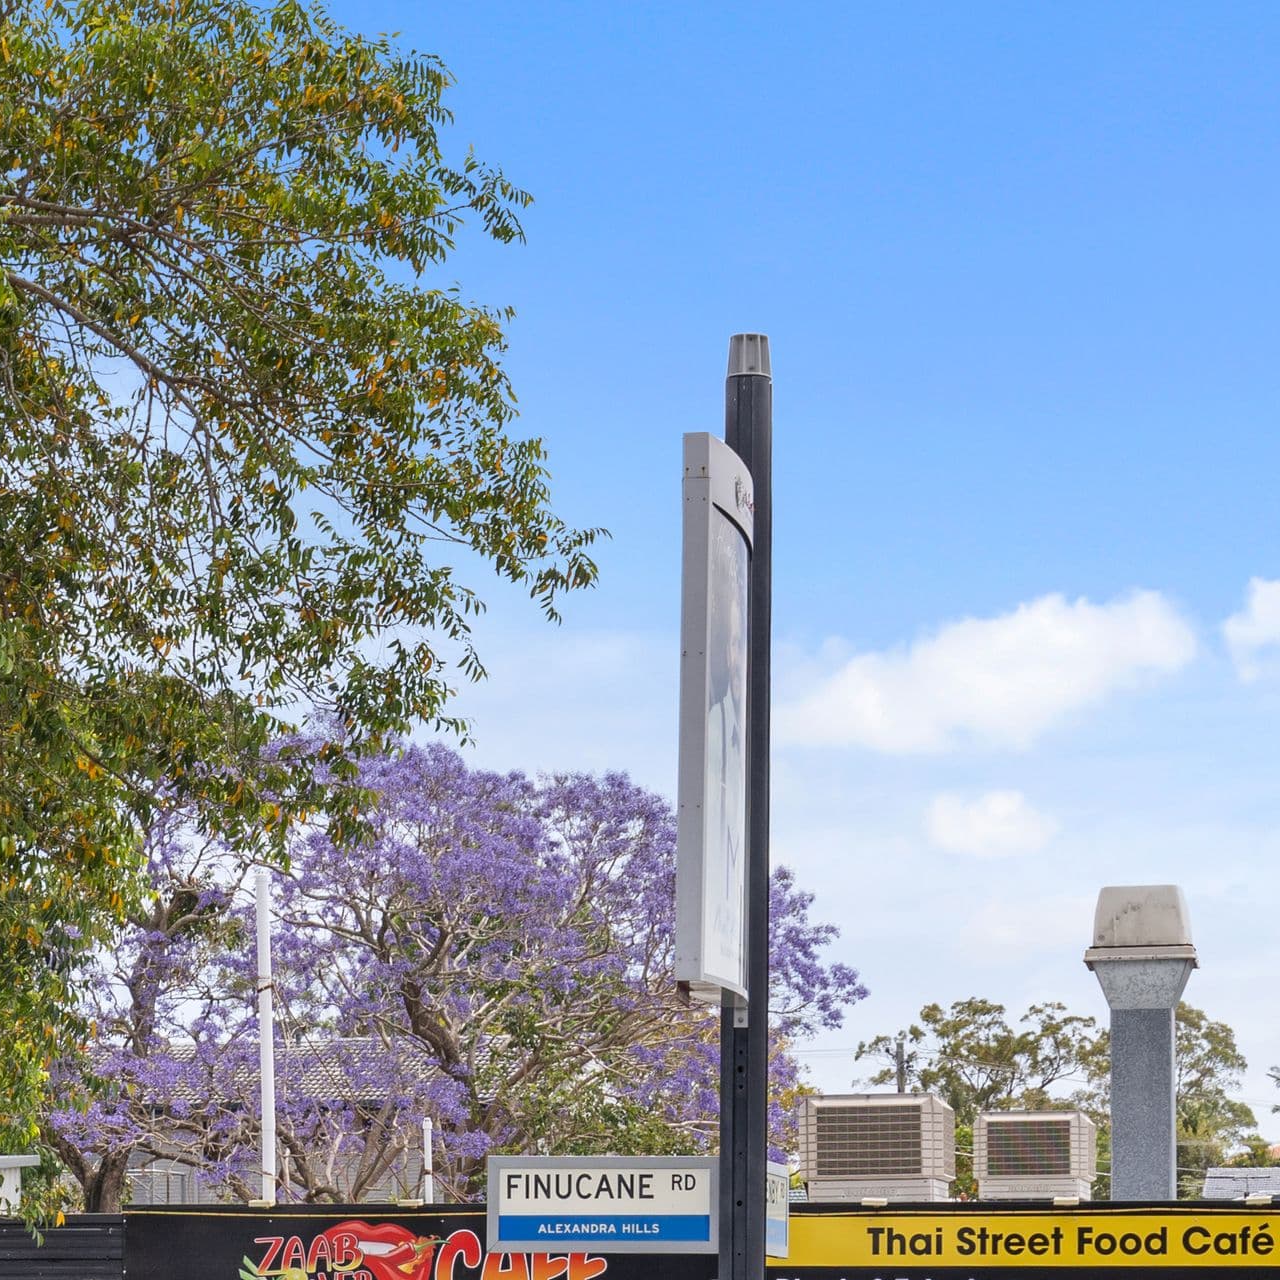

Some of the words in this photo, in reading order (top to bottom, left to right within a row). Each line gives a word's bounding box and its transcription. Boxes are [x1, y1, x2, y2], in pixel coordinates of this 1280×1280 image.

[506, 1173, 655, 1200] FINUCANE
[671, 1174, 696, 1191] RD
[537, 1223, 616, 1234] ALEXANDRA
[622, 1223, 660, 1234] HILLS
[867, 1227, 943, 1255] Thai
[956, 1227, 1064, 1255] Street
[1077, 1226, 1168, 1255] Food
[1182, 1222, 1274, 1255] Café
[254, 1232, 365, 1276] ZAAB
